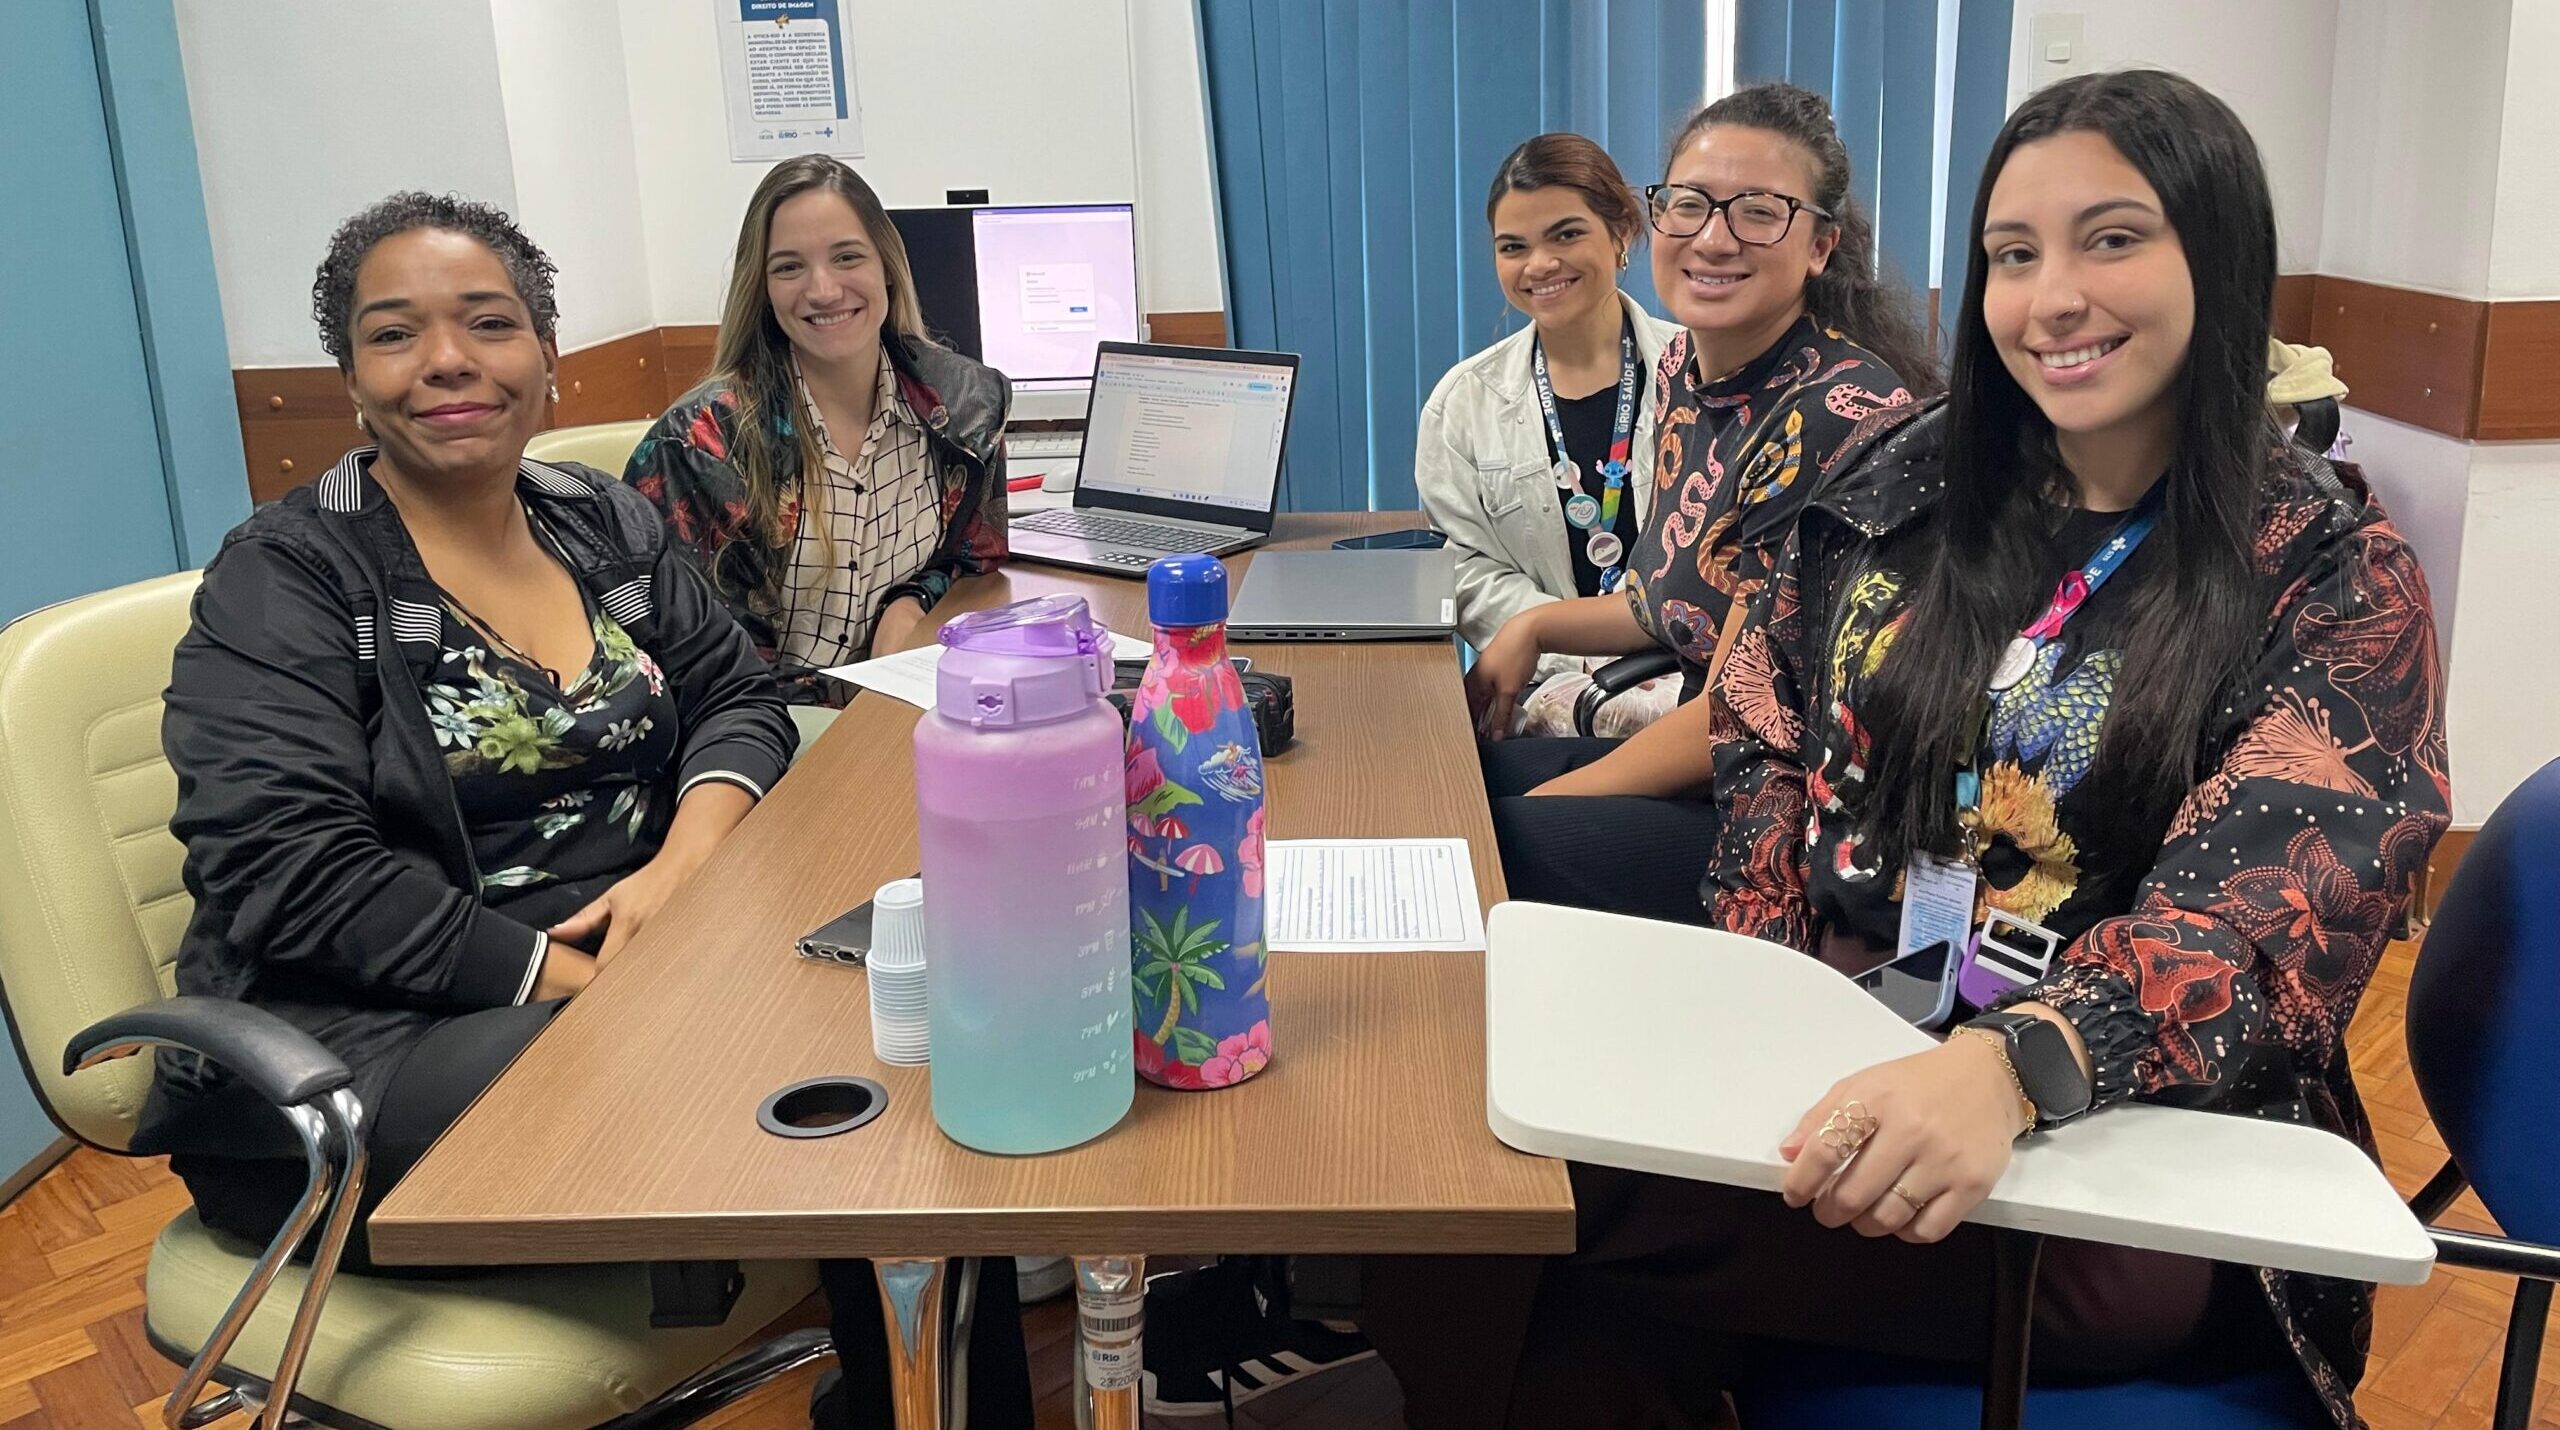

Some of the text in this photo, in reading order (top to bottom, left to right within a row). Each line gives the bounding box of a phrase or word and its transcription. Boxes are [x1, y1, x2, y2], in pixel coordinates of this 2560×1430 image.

[1534, 357, 1554, 416] RIO SAÚDE
[1620, 363, 1635, 424] RIO SAÚDE
